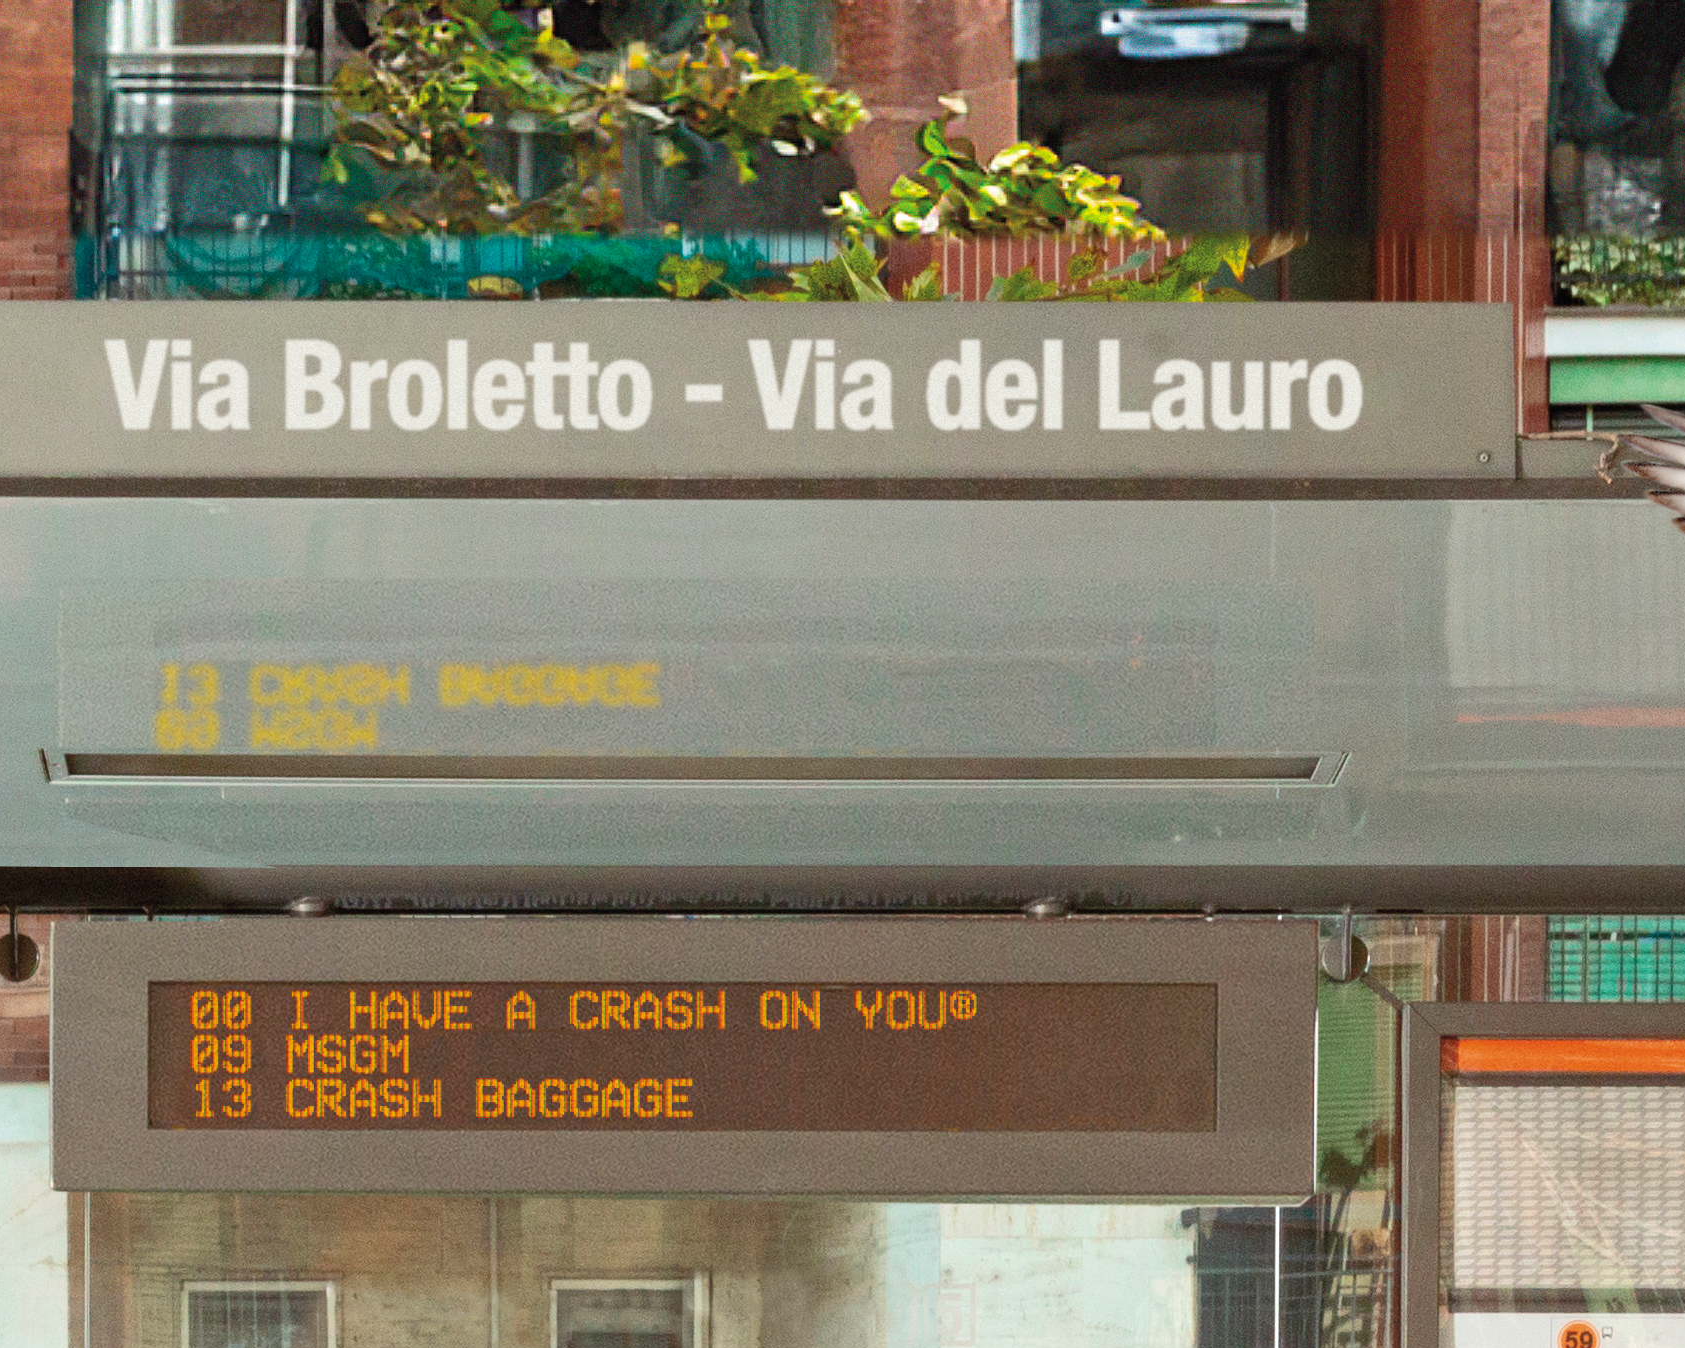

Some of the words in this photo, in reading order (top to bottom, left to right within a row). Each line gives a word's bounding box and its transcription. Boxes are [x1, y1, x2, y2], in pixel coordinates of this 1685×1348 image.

[104, 339, 252, 431] Via
[285, 339, 653, 431] Broletto
[685, 384, 723, 402] -
[747, 339, 894, 431] Via
[925, 339, 1064, 431] del
[1099, 339, 1365, 431] Lauro
[191, 990, 252, 1030] 00
[291, 990, 311, 1030] I
[349, 990, 473, 1030] HAVE
[506, 990, 537, 1030] A
[569, 990, 726, 1030] CRASH
[760, 990, 821, 1030] ON
[191, 1034, 252, 1074] 09
[286, 1034, 410, 1074] MSGM
[195, 1078, 252, 1118] 13
[286, 1078, 442, 1118] CRASH
[476, 1078, 694, 1118] BAGGAGE
